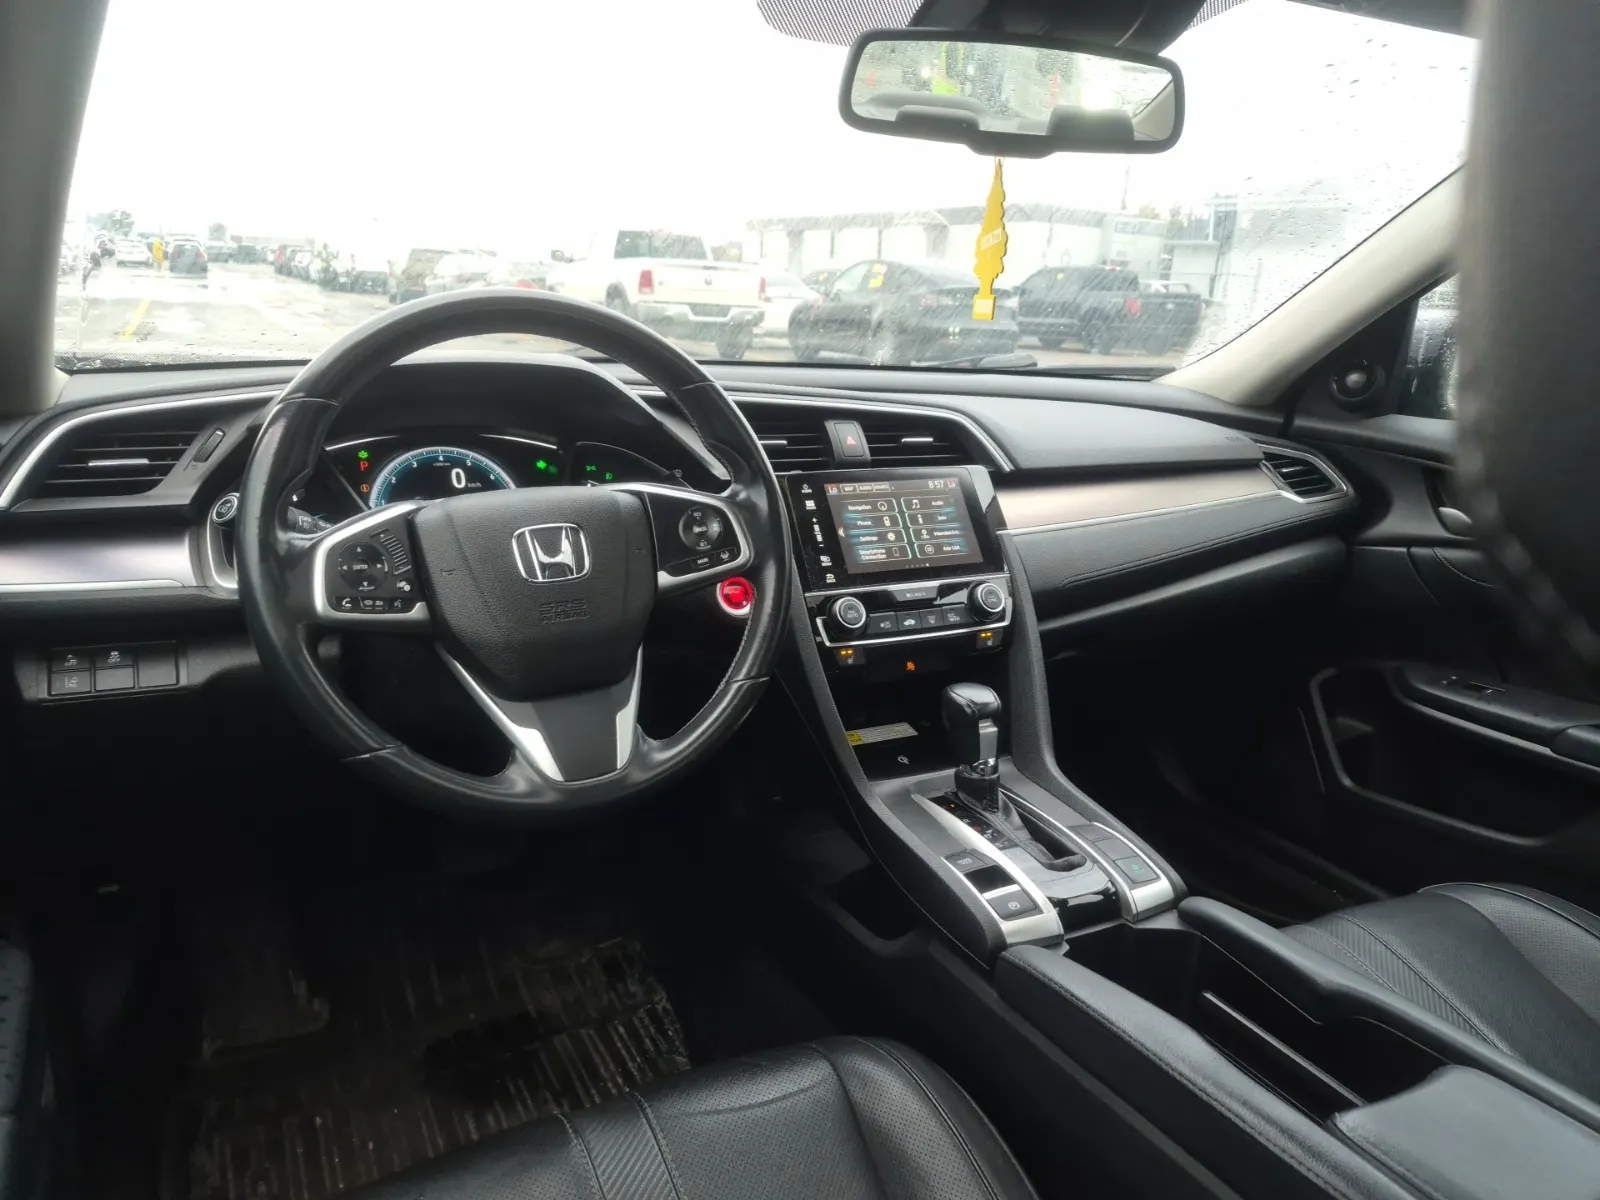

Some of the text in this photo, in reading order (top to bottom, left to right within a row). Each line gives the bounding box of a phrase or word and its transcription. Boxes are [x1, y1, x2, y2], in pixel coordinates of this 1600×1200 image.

[360, 461, 369, 471] P
[466, 459, 472, 467] 5
[391, 476, 396, 484] 2
[451, 468, 466, 489] 0
